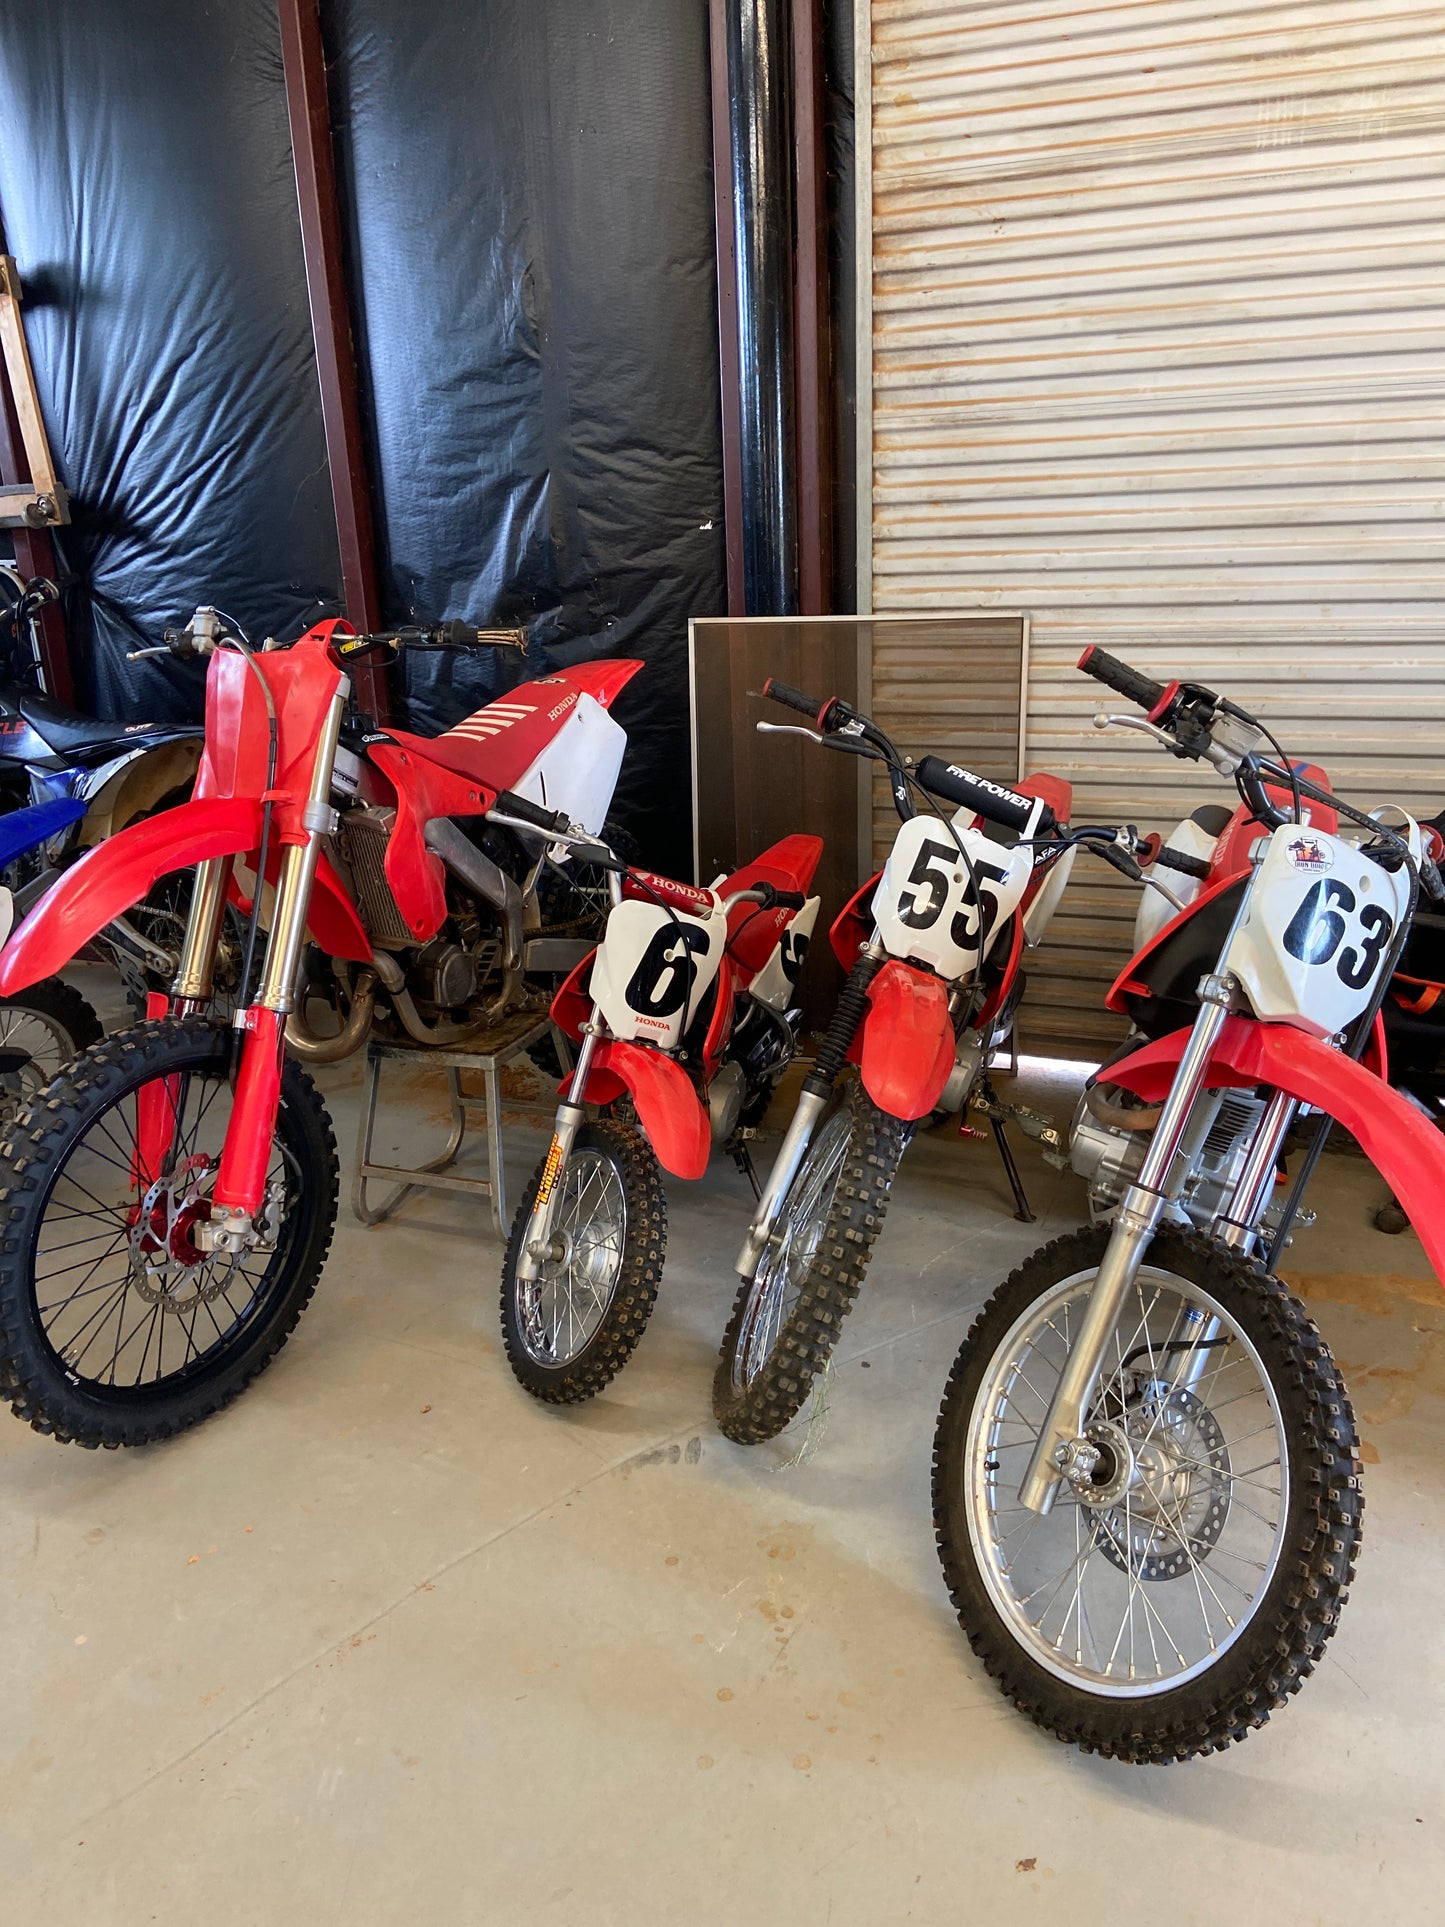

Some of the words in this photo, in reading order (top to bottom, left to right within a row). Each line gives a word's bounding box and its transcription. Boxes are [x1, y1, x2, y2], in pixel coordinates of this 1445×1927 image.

[547, 692, 578, 721] HONDA
[977, 780, 1033, 810] POWER
[651, 876, 709, 903] HONDA
[897, 838, 999, 950] 55
[1283, 878, 1393, 990] 63
[625, 921, 711, 1018] 6
[634, 1015, 671, 1031] HONDA
